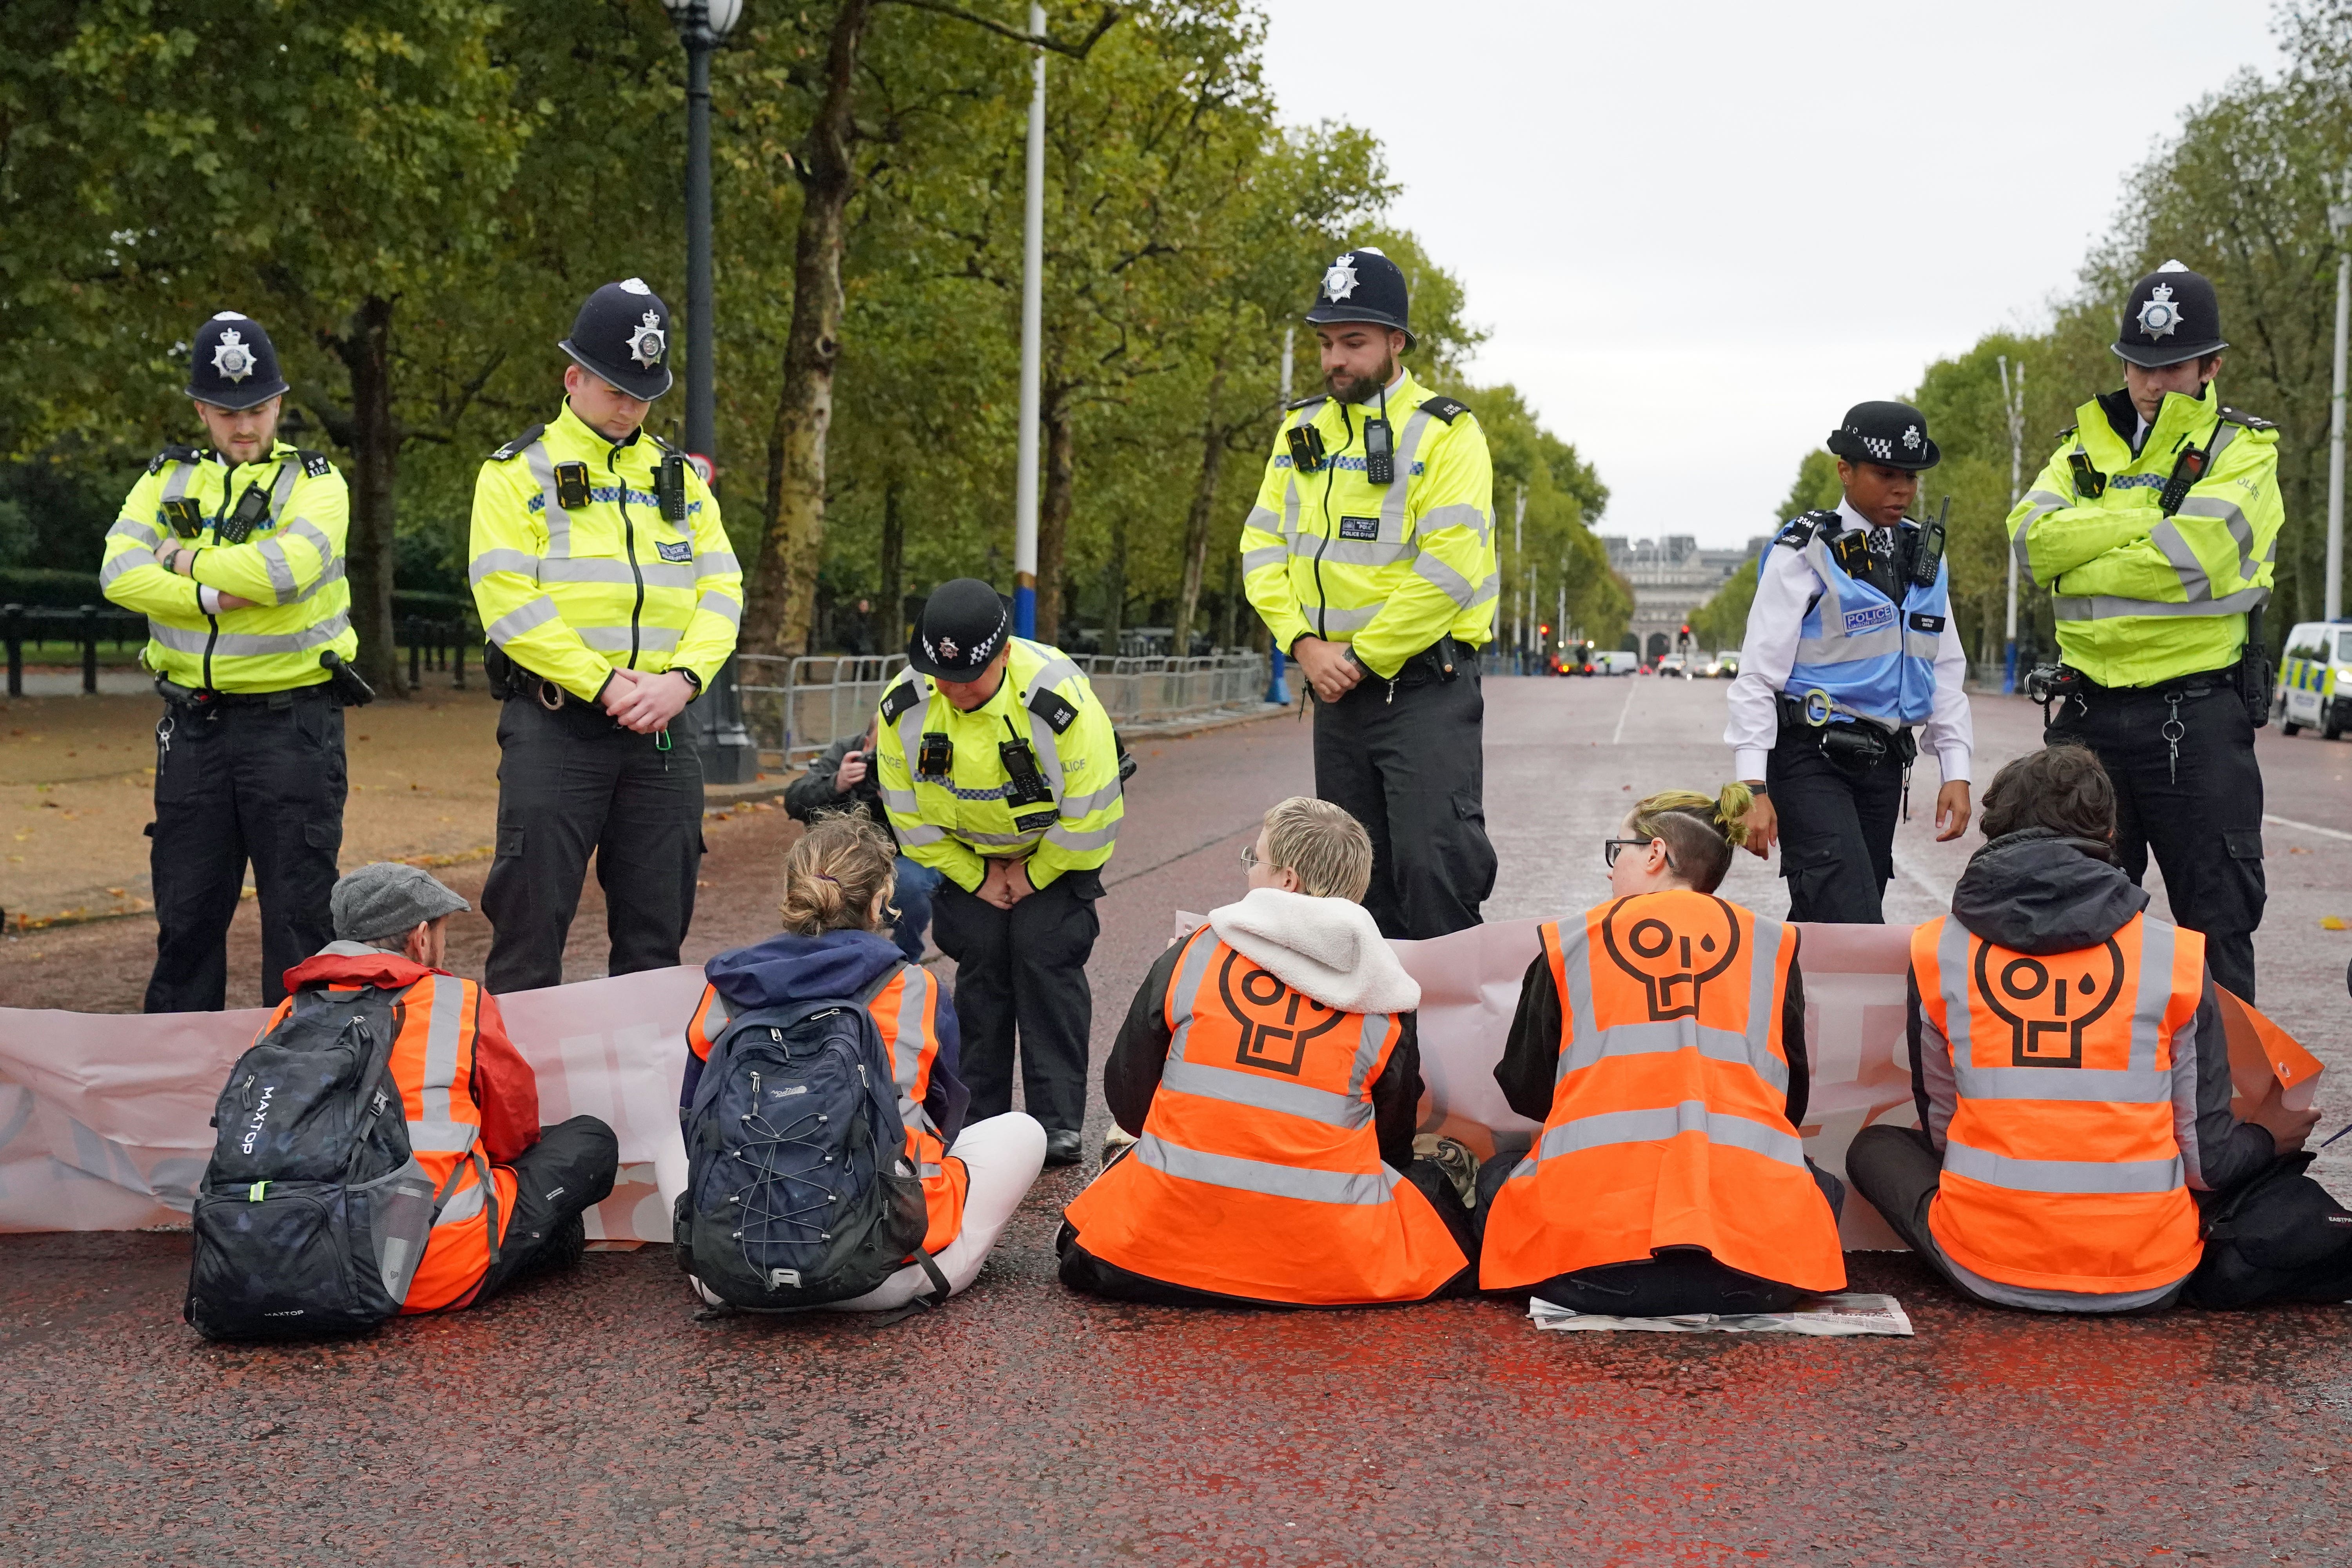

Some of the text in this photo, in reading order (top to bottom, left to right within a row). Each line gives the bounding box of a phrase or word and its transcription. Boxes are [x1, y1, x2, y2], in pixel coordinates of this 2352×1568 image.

[2237, 478, 2259, 501] OLICE
[1847, 606, 1891, 625] POLICE
[1054, 708, 1064, 720] SW
[242, 1087, 274, 1154] MAXTOP
